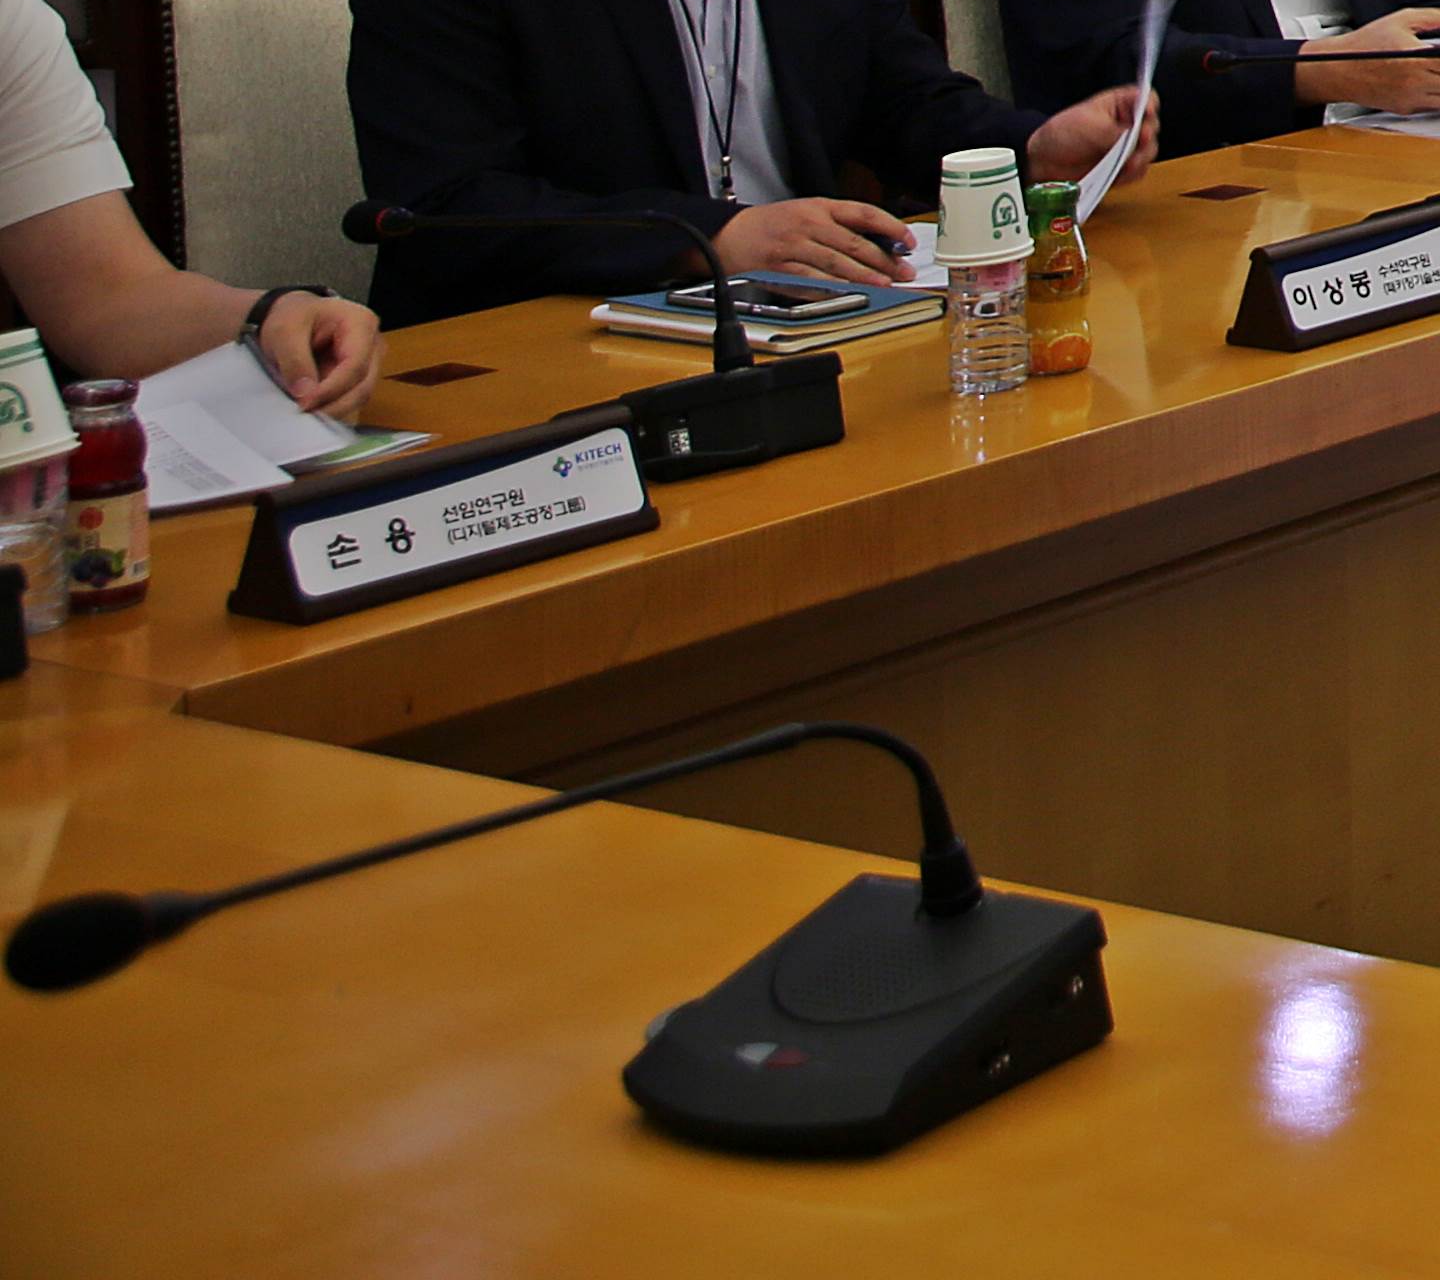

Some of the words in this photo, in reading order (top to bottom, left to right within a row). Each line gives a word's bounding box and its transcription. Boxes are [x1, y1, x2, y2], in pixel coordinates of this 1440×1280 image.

[1378, 254, 1431, 278] 수석연구원
[574, 442, 623, 465] KITECH
[442, 488, 525, 525] 선임연구원
[447, 496, 586, 545] (디지털제조공정그룹)
[327, 533, 361, 570] 손
[385, 517, 415, 554] 용
